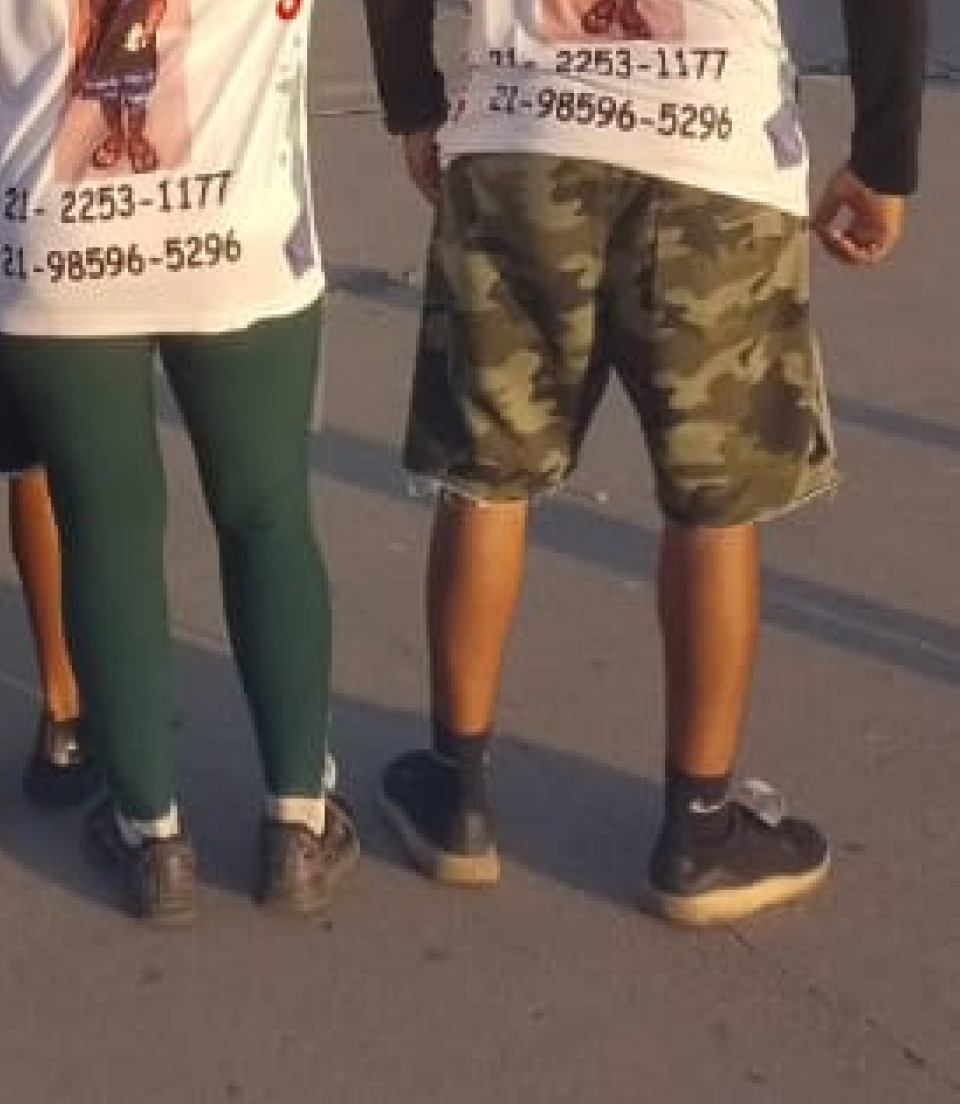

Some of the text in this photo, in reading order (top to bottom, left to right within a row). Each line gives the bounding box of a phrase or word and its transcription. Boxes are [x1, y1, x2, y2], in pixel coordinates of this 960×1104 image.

[556, 49, 728, 80] 2253-1177
[4, 170, 234, 224] 21- 2253-1177
[2, 226, 241, 283] 21-98596-5296
